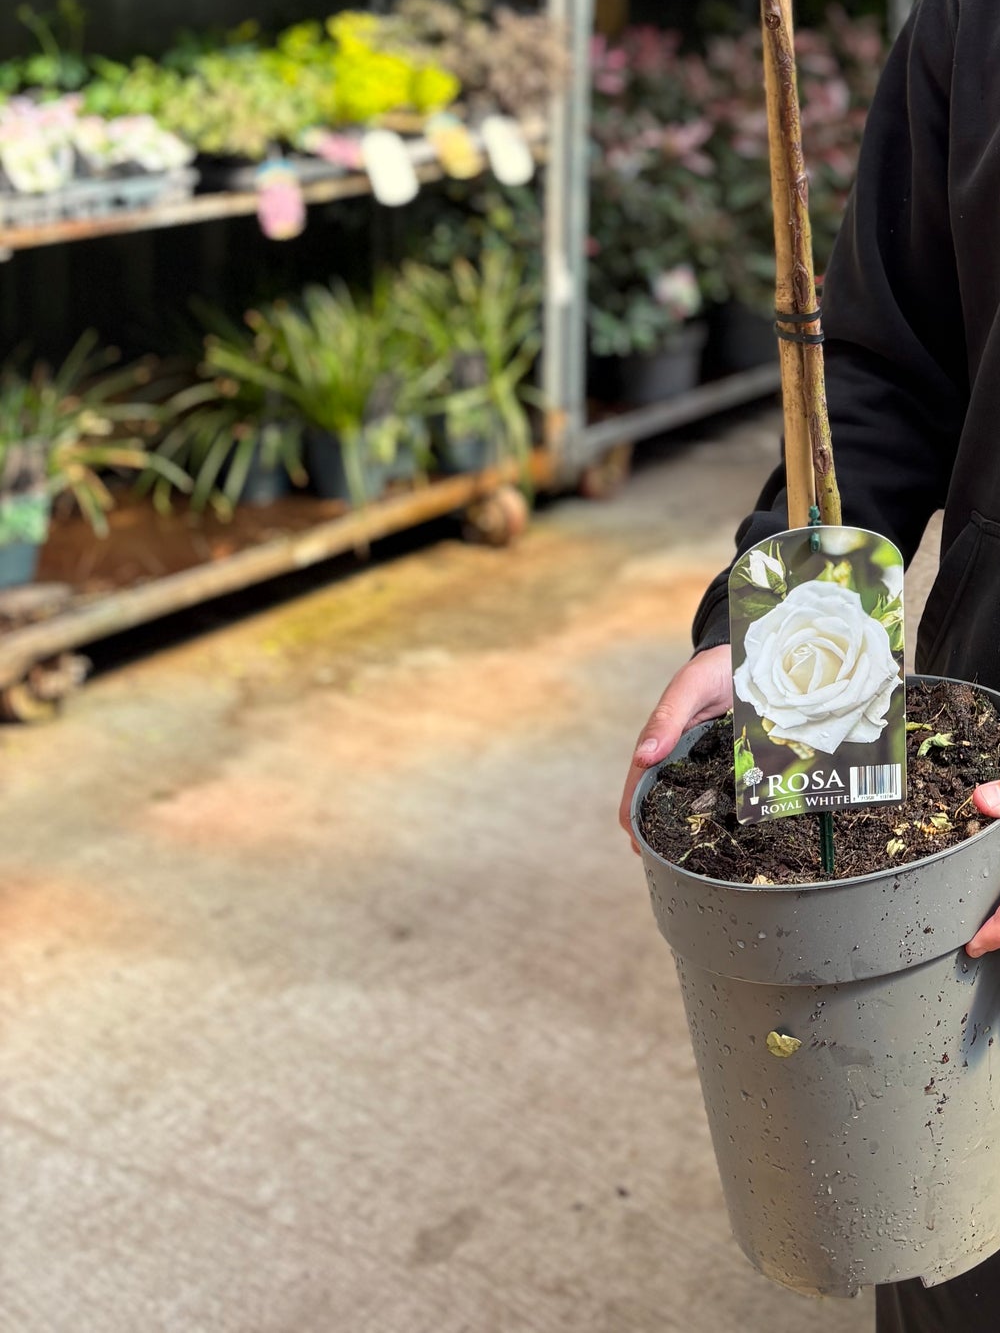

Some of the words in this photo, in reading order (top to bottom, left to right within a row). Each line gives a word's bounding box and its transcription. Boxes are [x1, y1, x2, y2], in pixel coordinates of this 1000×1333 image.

[766, 769, 845, 798] ROSA
[761, 800, 802, 816] ROYAL
[805, 794, 850, 807] WHITE
